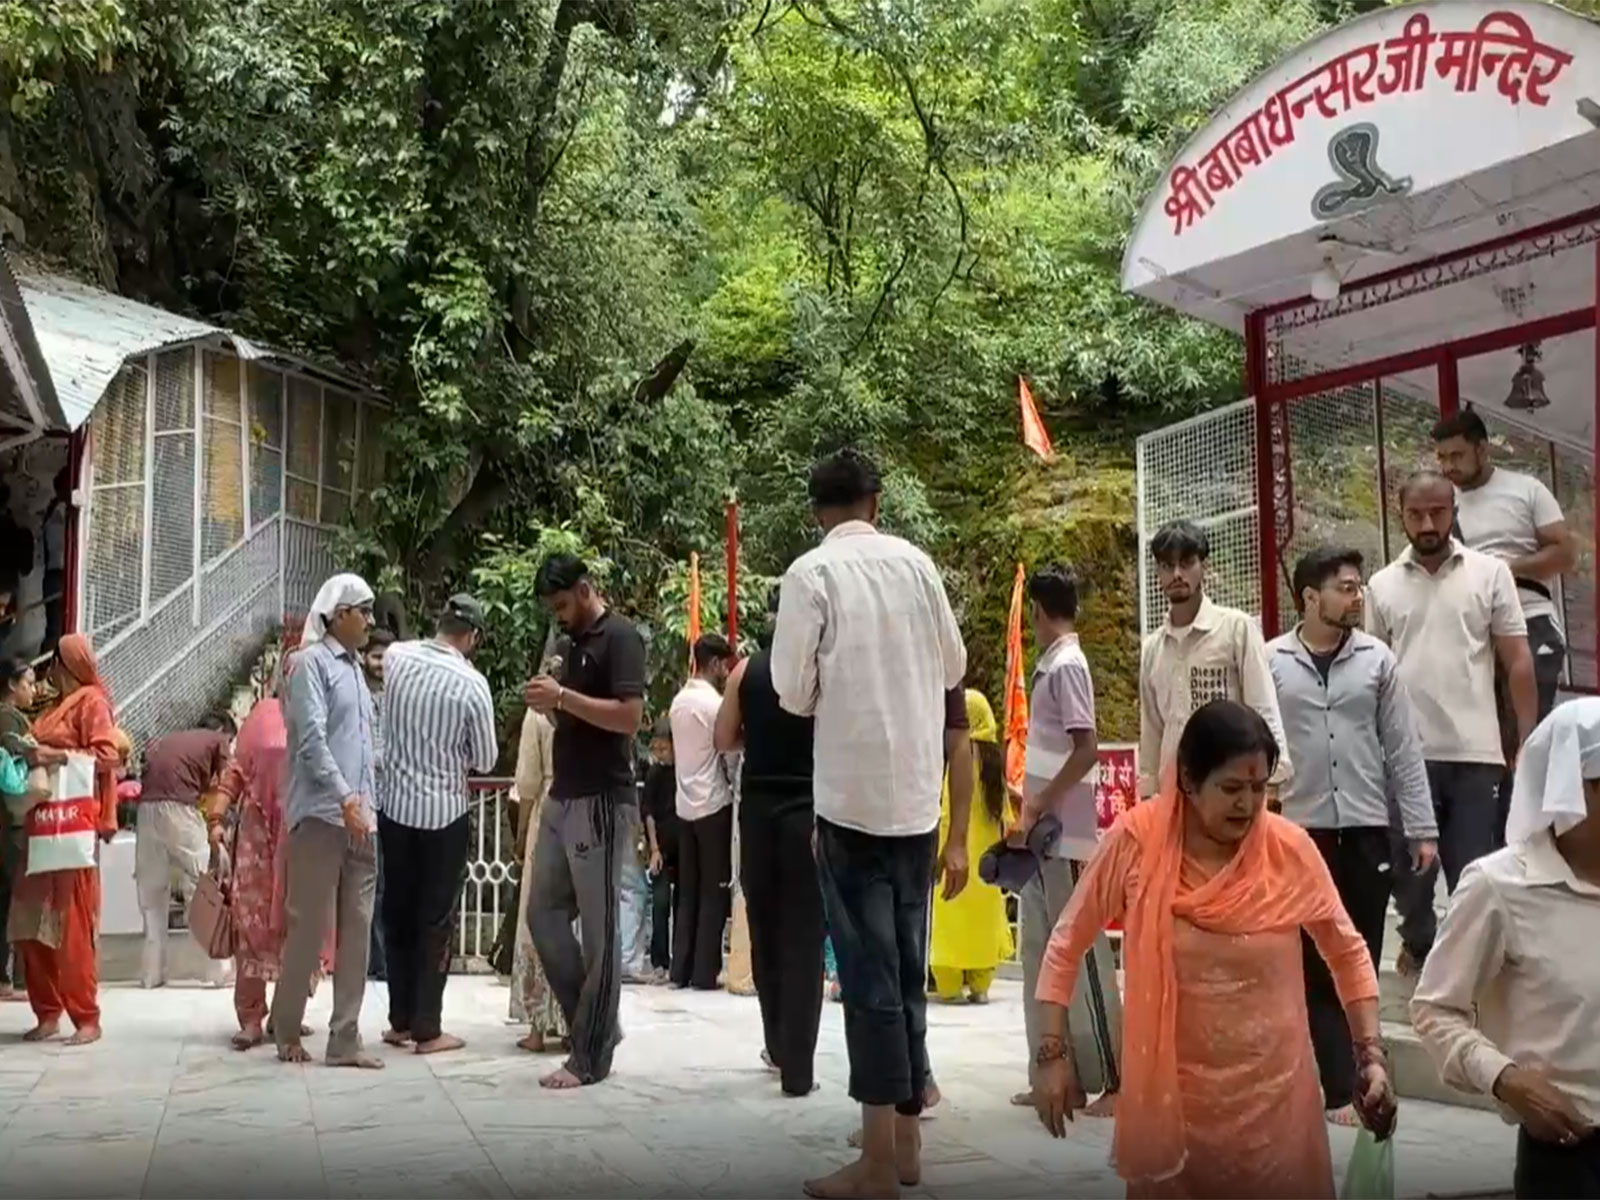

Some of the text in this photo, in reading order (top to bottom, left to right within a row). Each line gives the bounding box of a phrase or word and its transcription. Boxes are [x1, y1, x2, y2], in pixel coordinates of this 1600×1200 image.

[1164, 166, 1215, 236] श्री
[1198, 108, 1272, 191] बाबा
[1377, 13, 1438, 95] जी
[1435, 11, 1575, 106] मन्दिर
[1191, 666, 1227, 677] Diesel
[1191, 678, 1227, 689] Diesel
